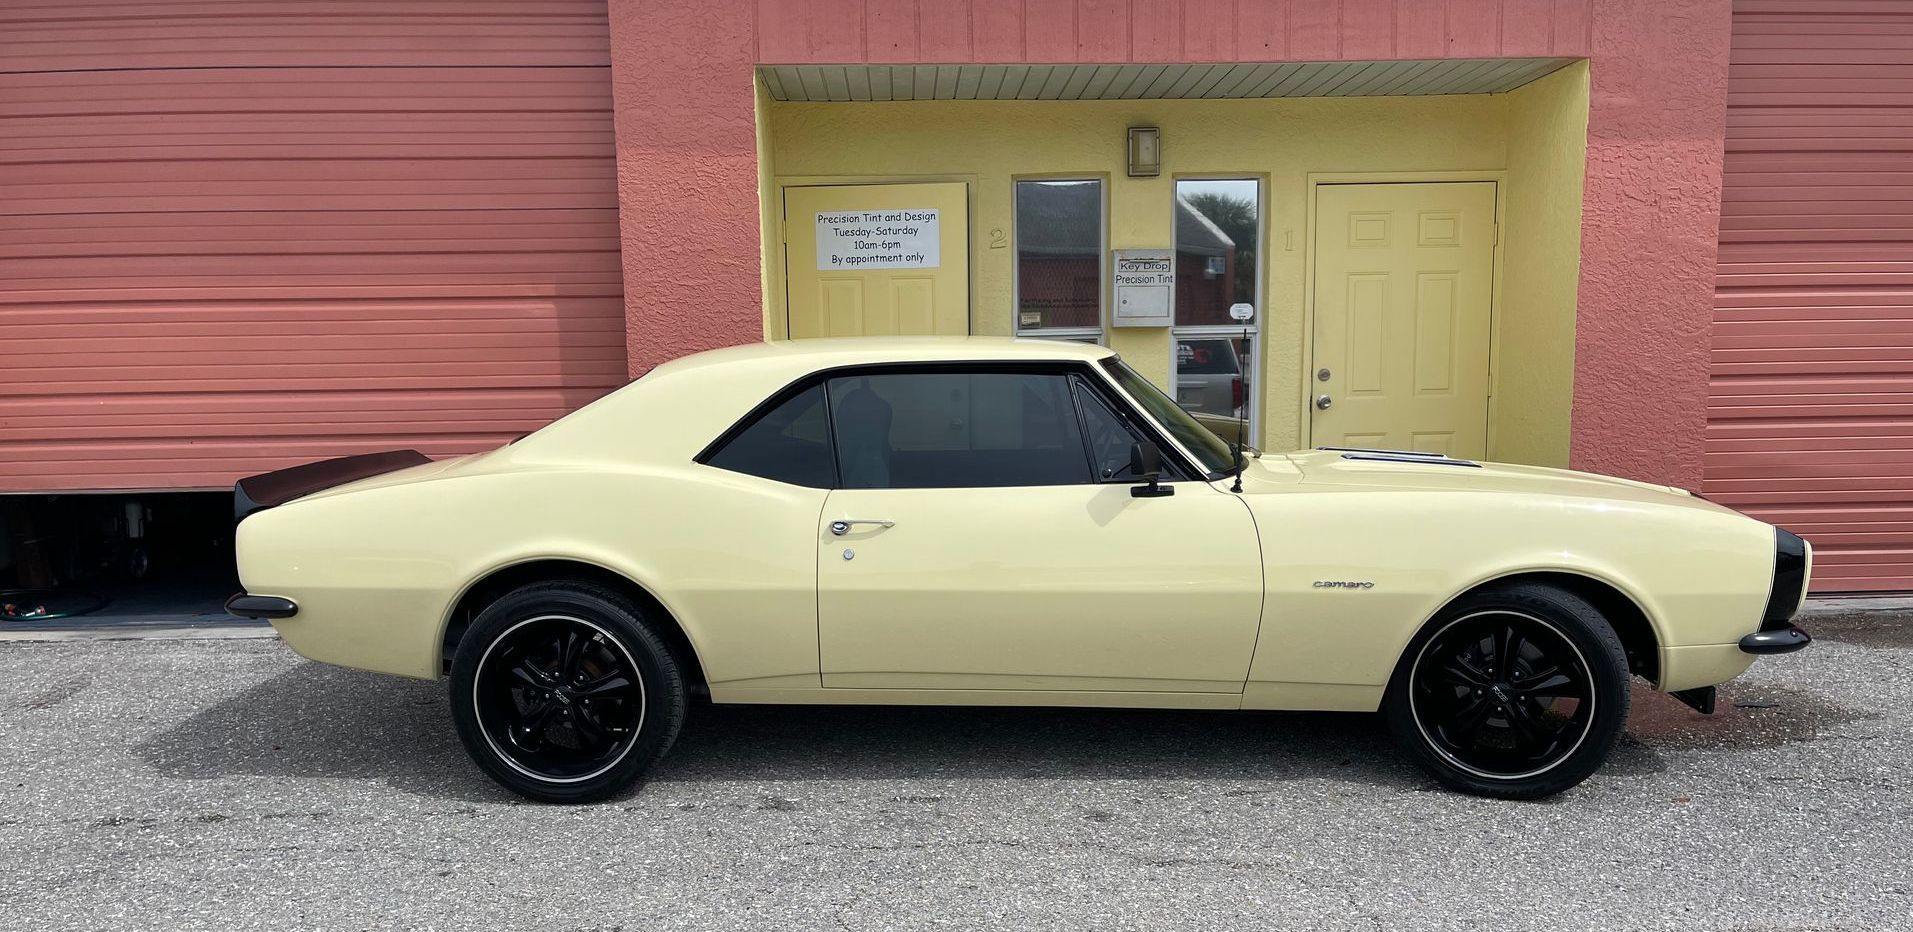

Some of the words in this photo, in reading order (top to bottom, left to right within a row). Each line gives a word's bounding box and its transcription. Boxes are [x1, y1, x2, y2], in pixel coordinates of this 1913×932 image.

[818, 214, 859, 224] Precision
[863, 213, 882, 222] Tint
[885, 212, 901, 222] and
[904, 211, 936, 223] Design
[833, 226, 919, 238] Tuesday-Saturday
[990, 225, 1007, 249] 2
[854, 240, 901, 251] 10am-6pm
[831, 254, 843, 266] By
[845, 253, 902, 266] appointment
[905, 251, 924, 264] only
[1120, 262, 1140, 272] Key
[1143, 262, 1168, 271] Drop
[1115, 274, 1155, 284] Precision
[1157, 274, 1173, 283] Tint
